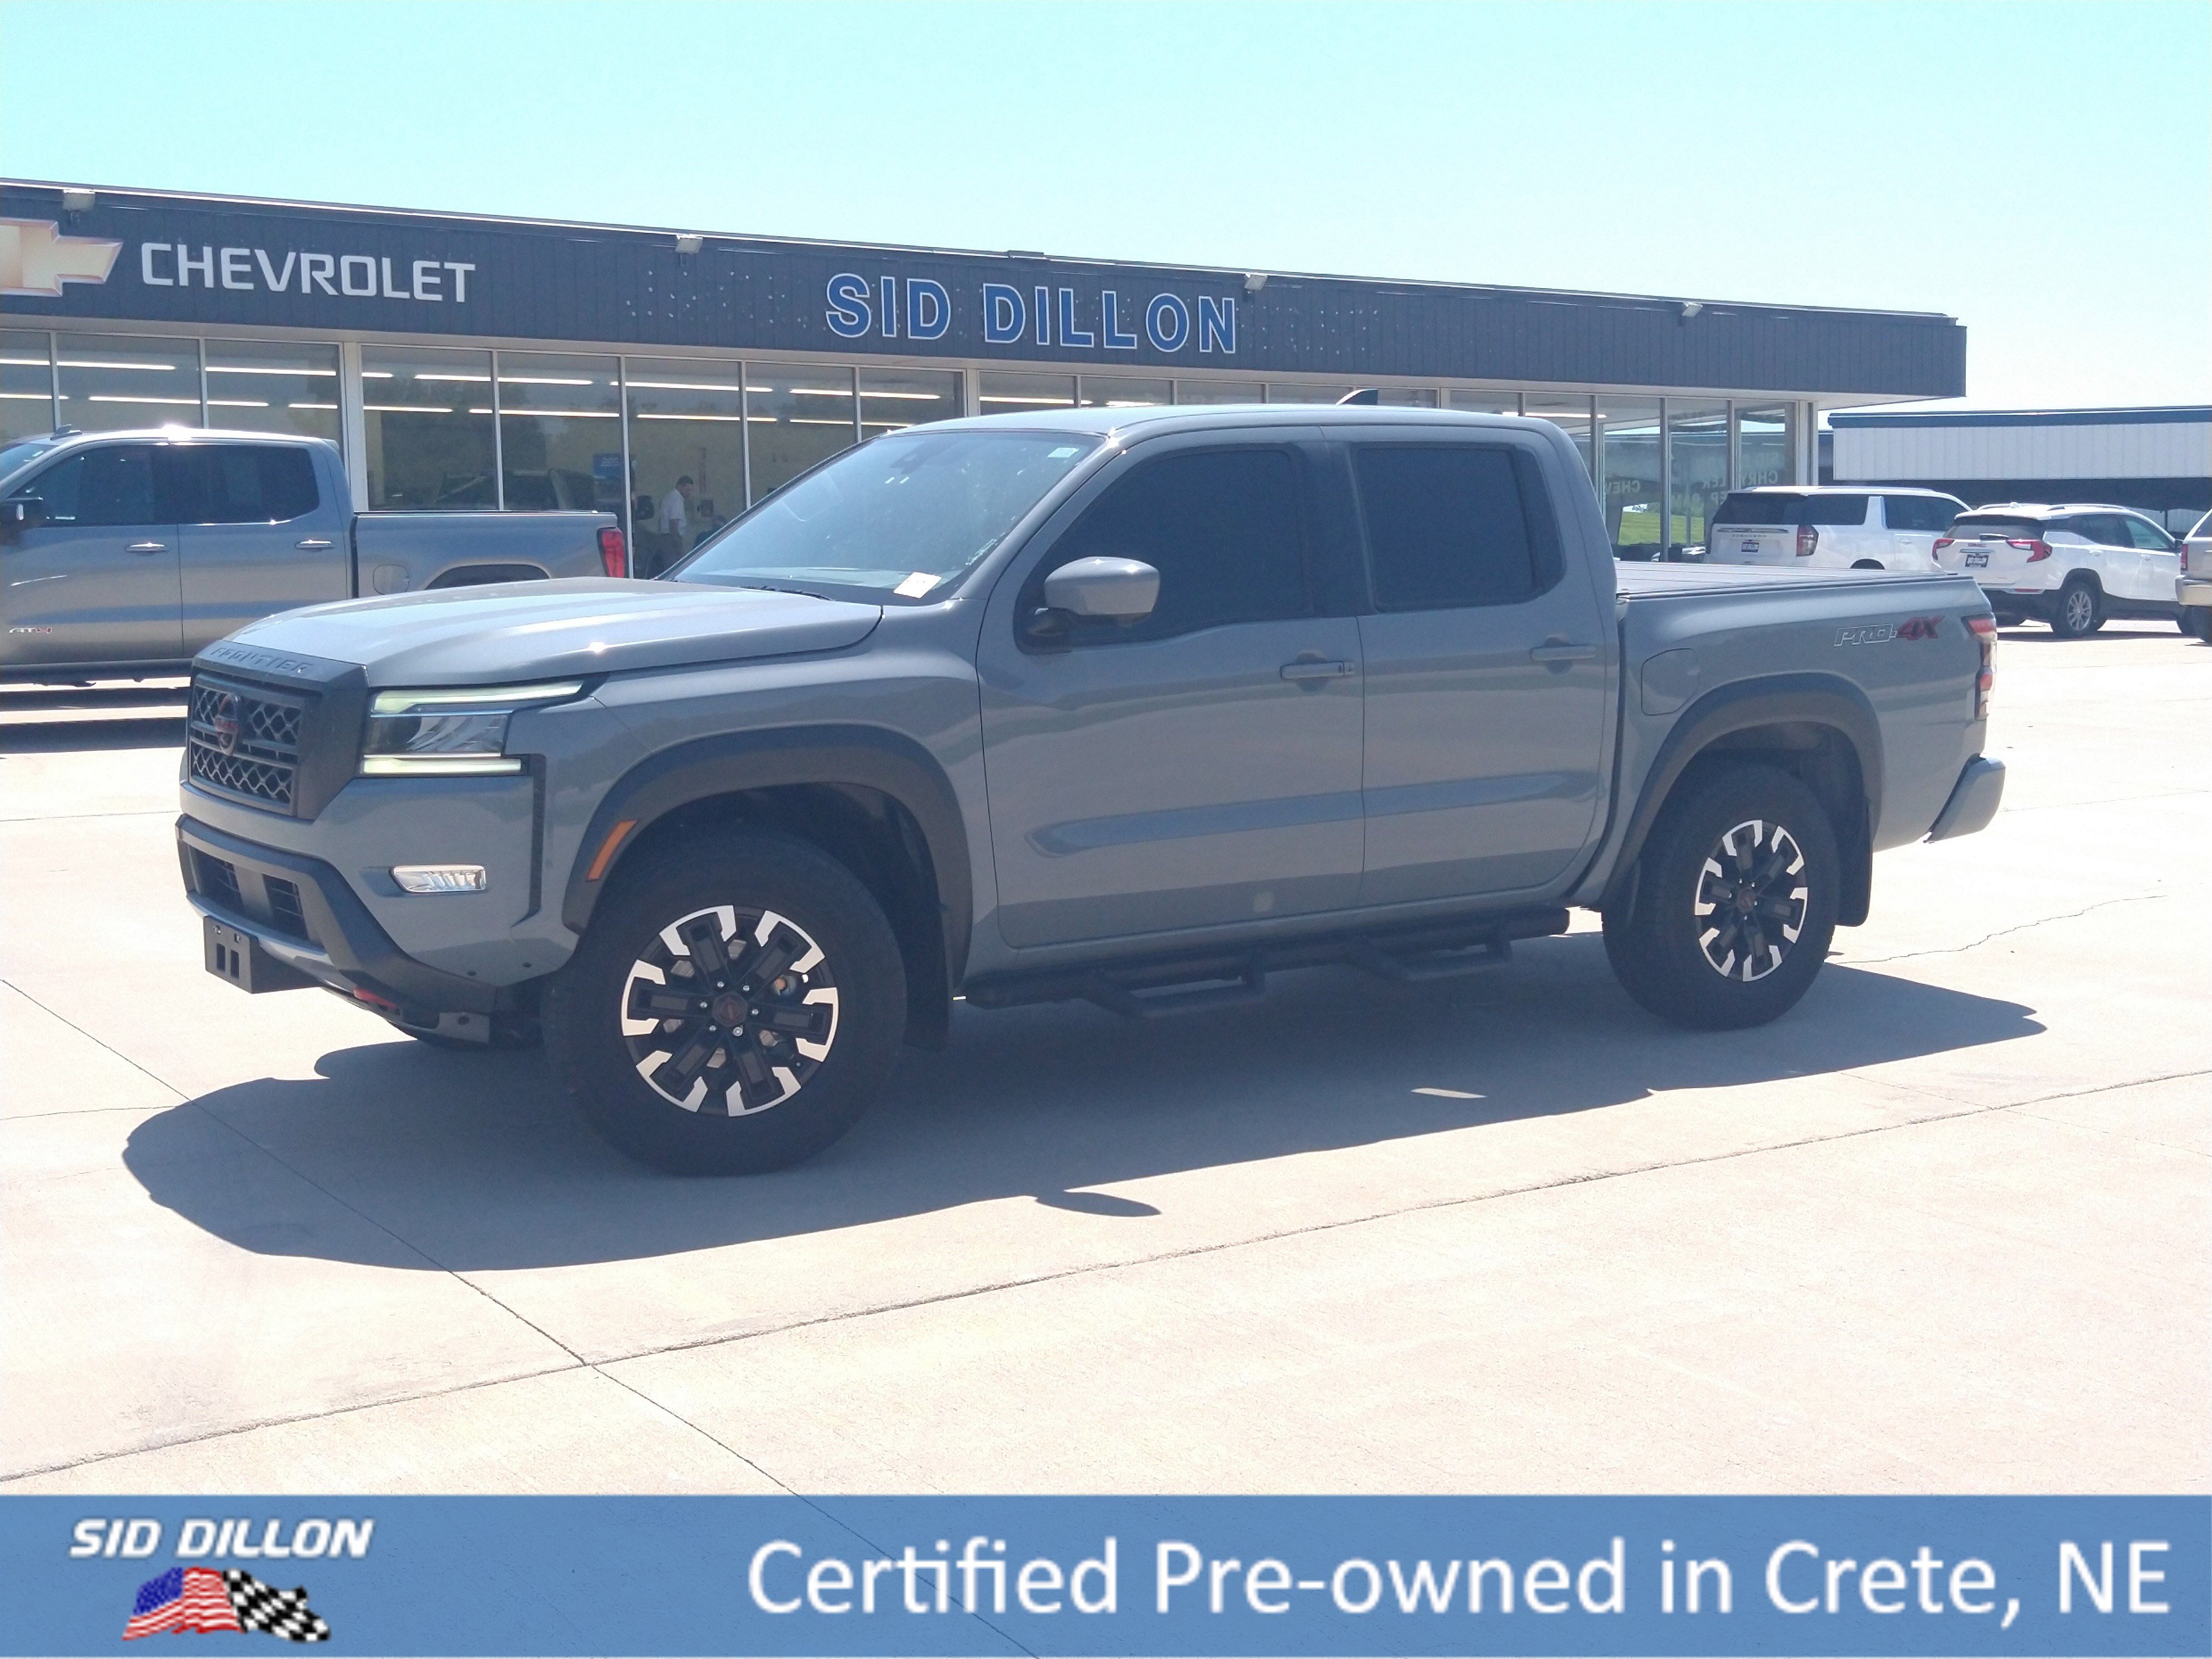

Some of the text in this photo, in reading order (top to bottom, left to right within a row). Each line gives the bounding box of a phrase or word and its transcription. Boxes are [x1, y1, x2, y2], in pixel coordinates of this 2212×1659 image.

[140, 242, 476, 303] CHEVROLET
[826, 273, 1237, 354] SID DILLON
[210, 646, 314, 671] FRONTIER
